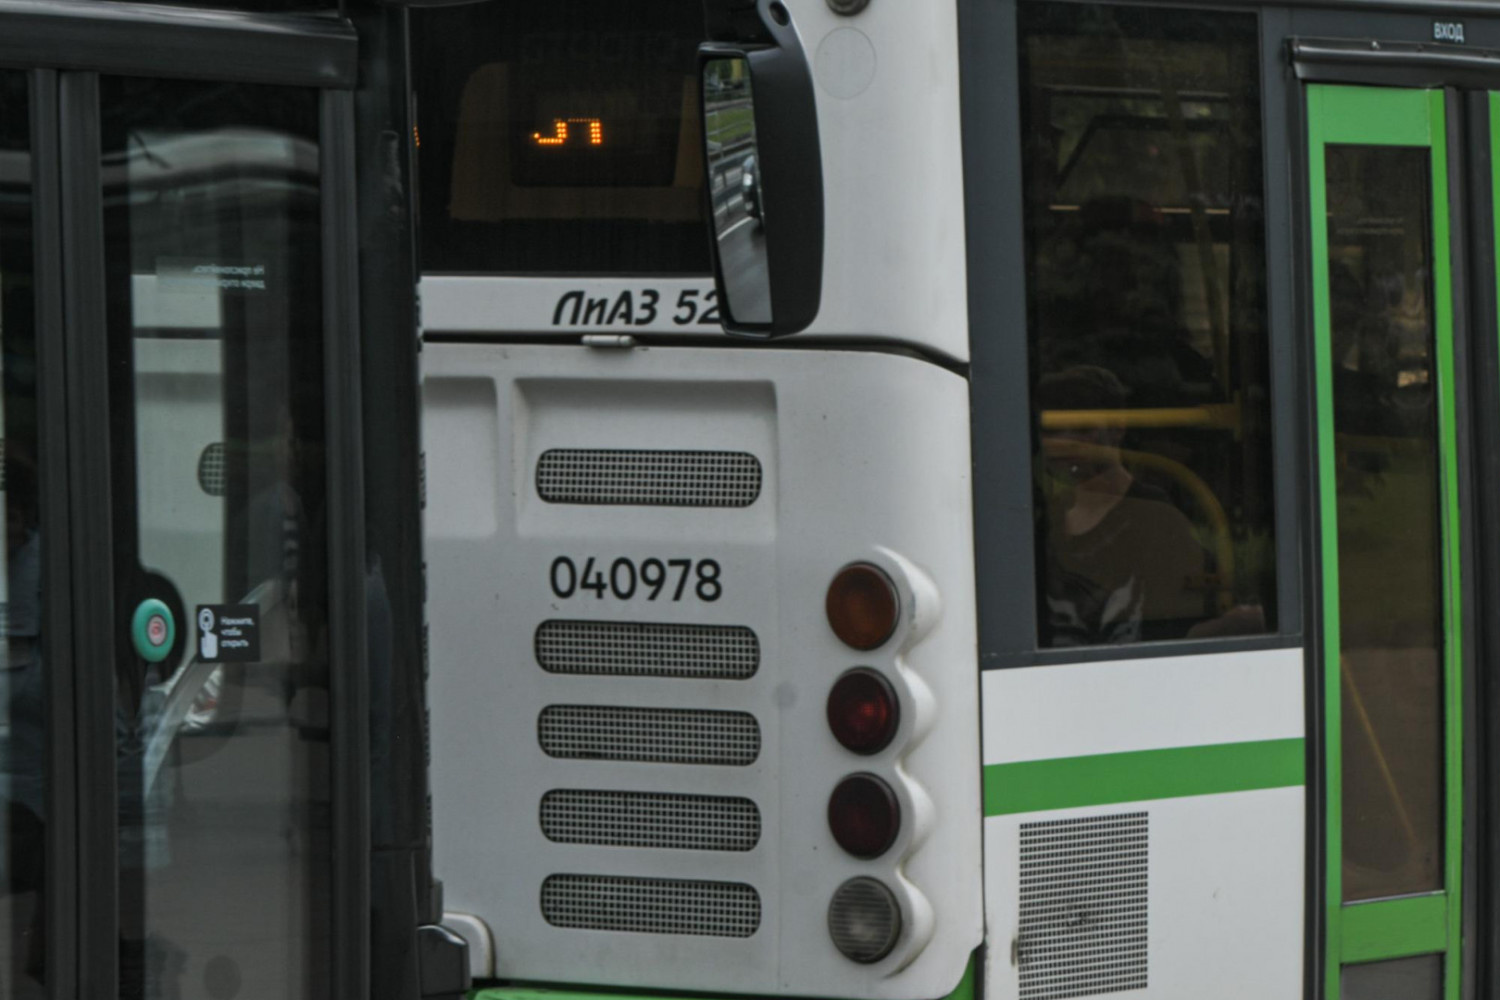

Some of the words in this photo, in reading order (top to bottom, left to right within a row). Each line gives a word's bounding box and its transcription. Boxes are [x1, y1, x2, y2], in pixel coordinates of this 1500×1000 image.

[1434, 22, 1464, 43] ВХОД
[552, 289, 660, 326] ЛиАЗ
[549, 555, 723, 603] 040978
